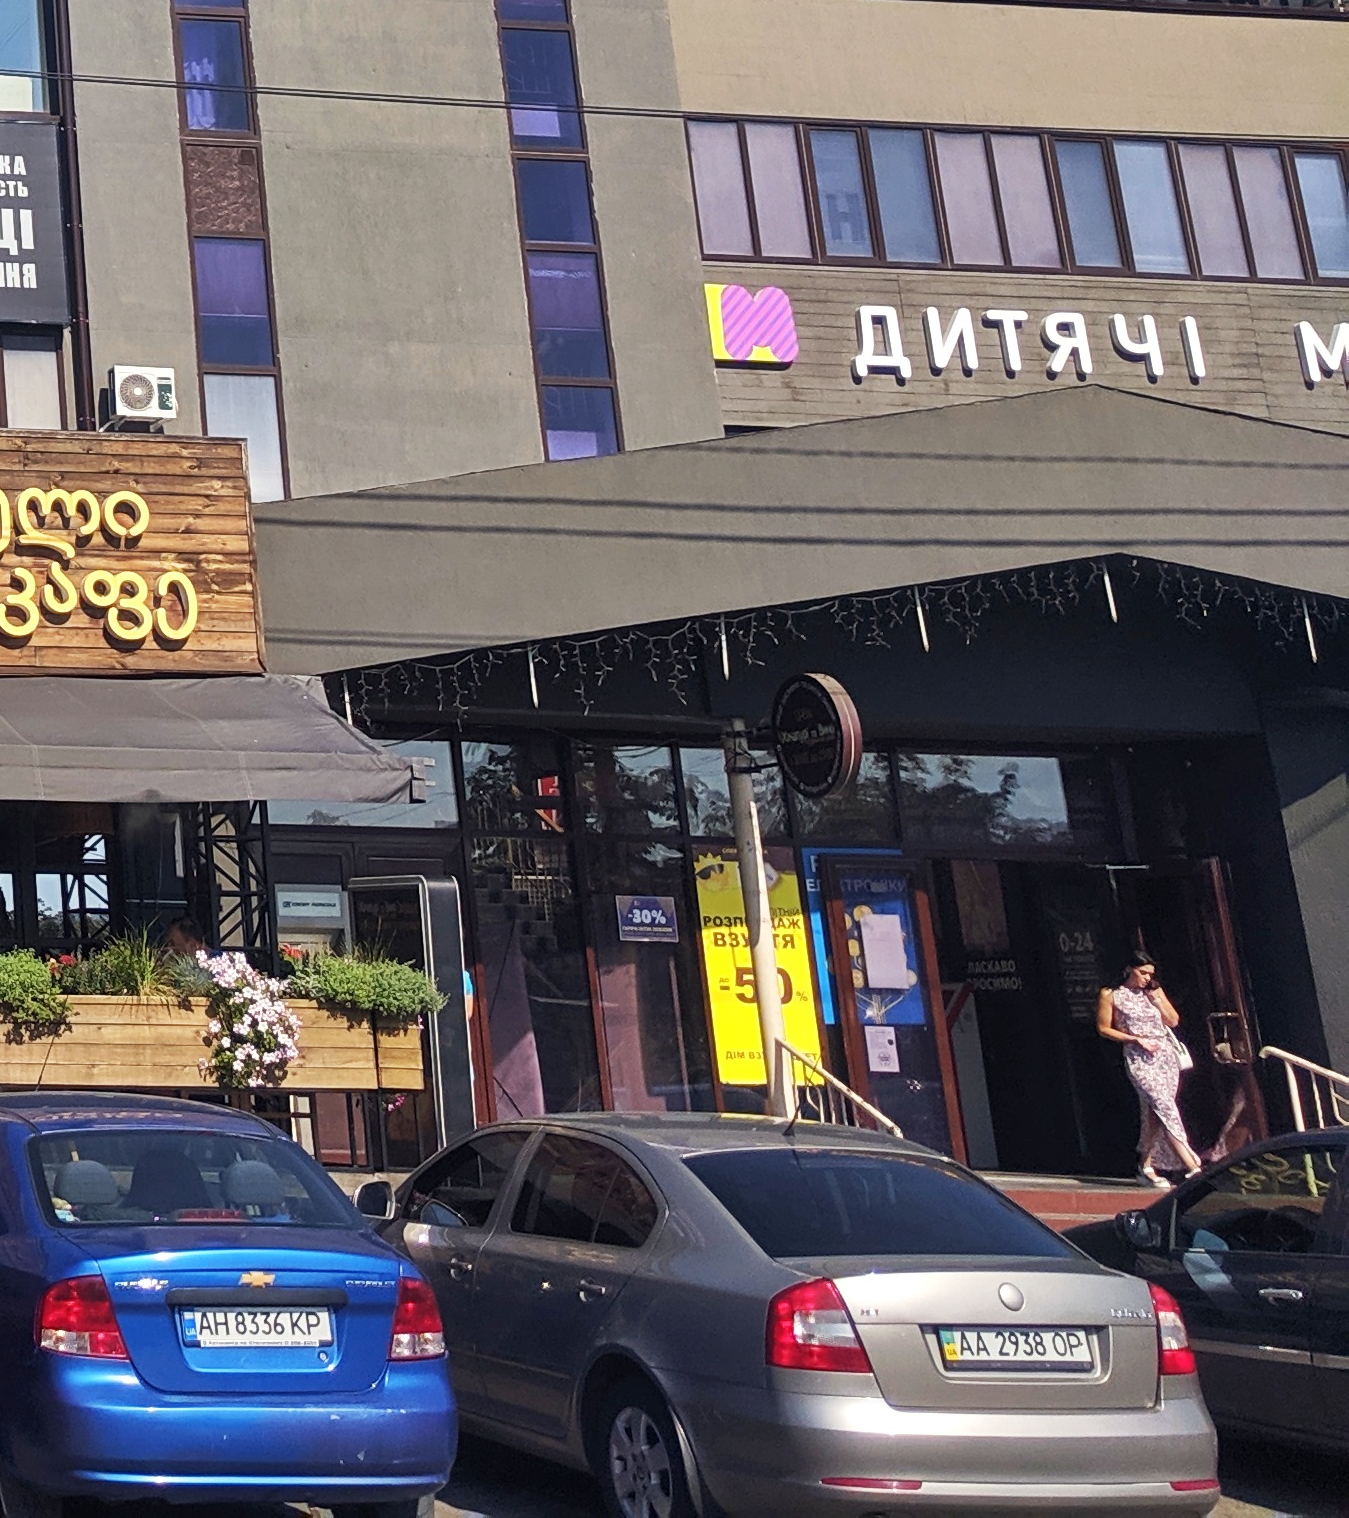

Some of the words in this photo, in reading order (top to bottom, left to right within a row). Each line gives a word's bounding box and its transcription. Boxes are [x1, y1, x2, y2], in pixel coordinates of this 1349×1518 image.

[853, 304, 1206, 381] ДИТЯЧІ
[628, 909, 667, 925] -30%
[199, 1311, 230, 1335] AH
[235, 1311, 285, 1336] 8336
[291, 1311, 321, 1336] KP
[960, 1332, 991, 1357] AA
[995, 1331, 1047, 1357] 2938
[1053, 1331, 1082, 1357] OP
